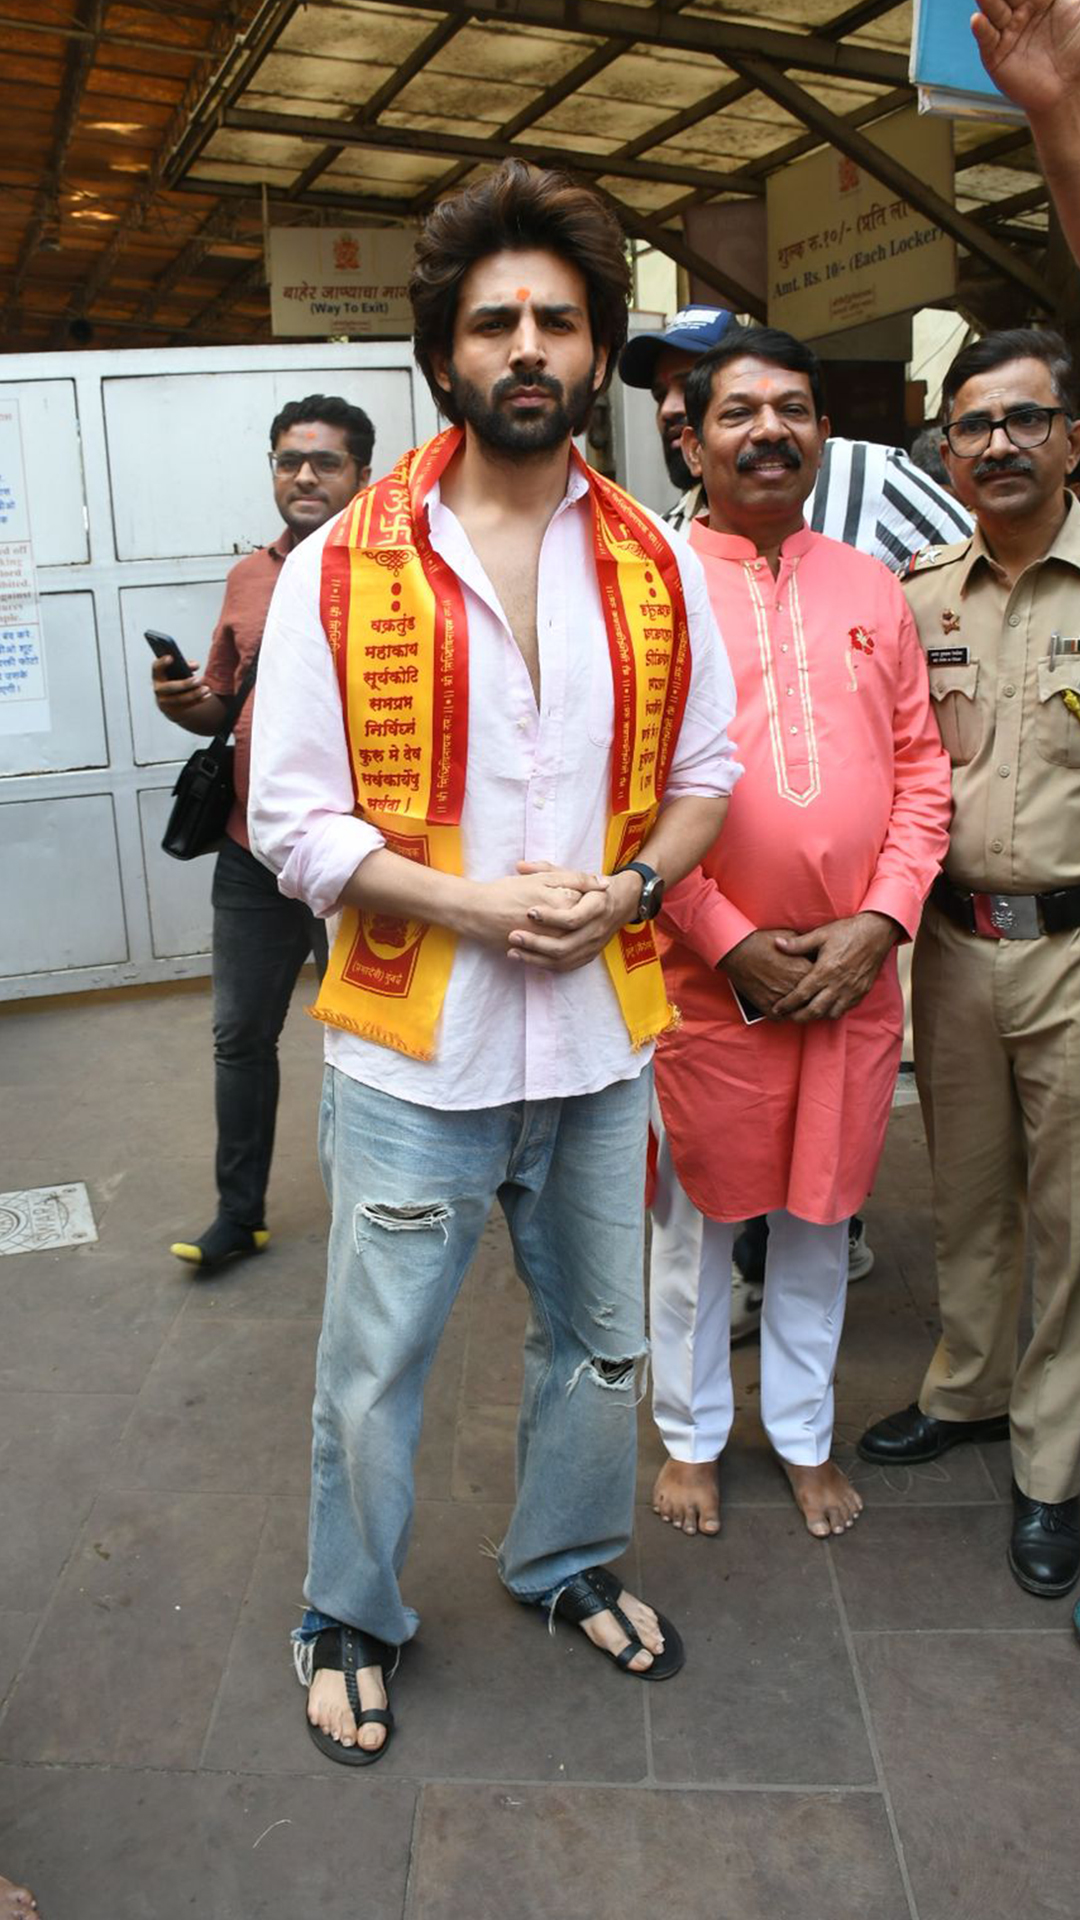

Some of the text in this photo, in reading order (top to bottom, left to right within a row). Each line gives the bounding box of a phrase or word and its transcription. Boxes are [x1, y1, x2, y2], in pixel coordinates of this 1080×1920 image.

[773, 277, 801, 298] Amt.
[803, 271, 822, 289] Rs.
[848, 244, 887, 273] (Each
[889, 226, 945, 260] Locker)
[283, 281, 317, 301] बाहेर
[310, 303, 389, 316] (Way To Exit)
[0, 591, 31, 602] gainst
[371, 613, 416, 637] वक्रतुंड
[365, 642, 419, 660] महाकाय
[363, 664, 419, 691] सूर्यकोटि
[369, 695, 413, 712] समप्रभ
[359, 744, 422, 766] कुरु मे देव
[367, 795, 401, 812] सर्वदा
